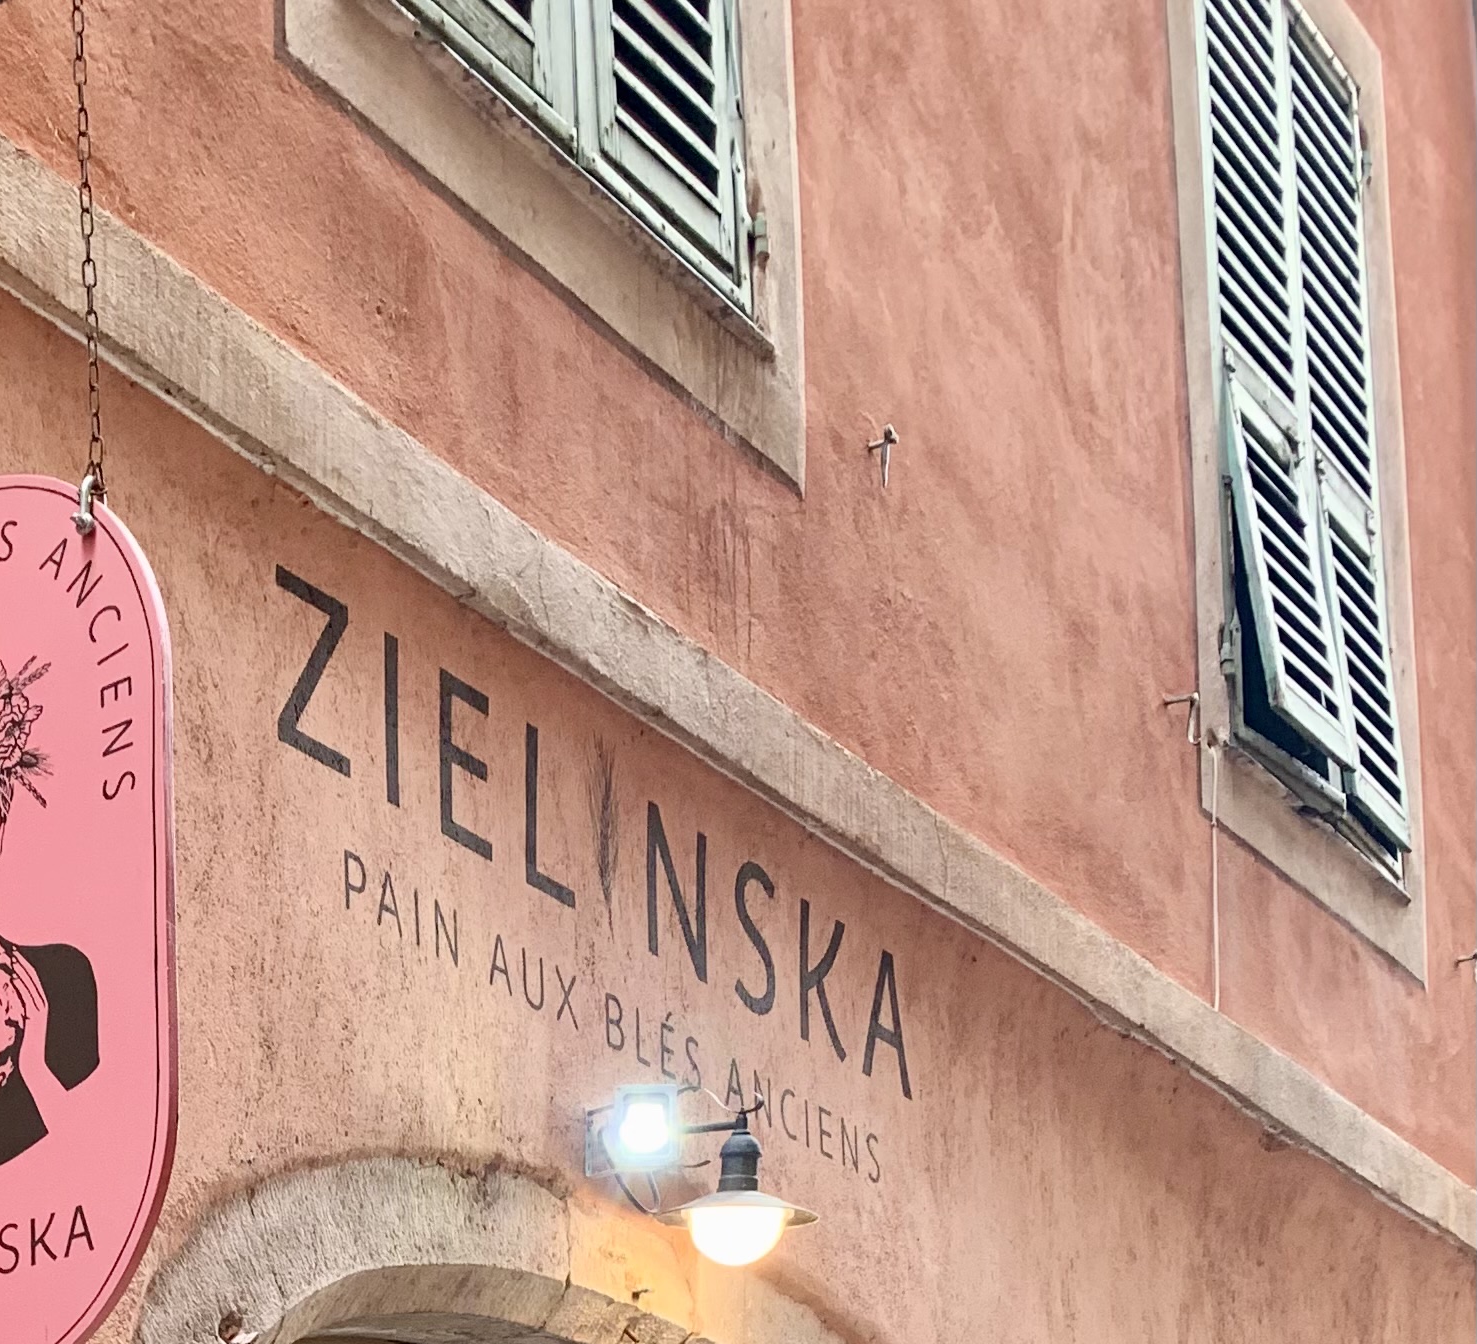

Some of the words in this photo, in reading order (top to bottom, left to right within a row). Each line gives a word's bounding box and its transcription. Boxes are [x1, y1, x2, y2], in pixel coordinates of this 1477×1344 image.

[39, 537, 136, 801] ANCIENS
[275, 563, 912, 1101] ZIELINSKA
[343, 848, 460, 968] PAIN
[489, 934, 579, 1030] AUX
[604, 992, 702, 1091] BLÉS
[725, 1057, 881, 1184] ANCIENS
